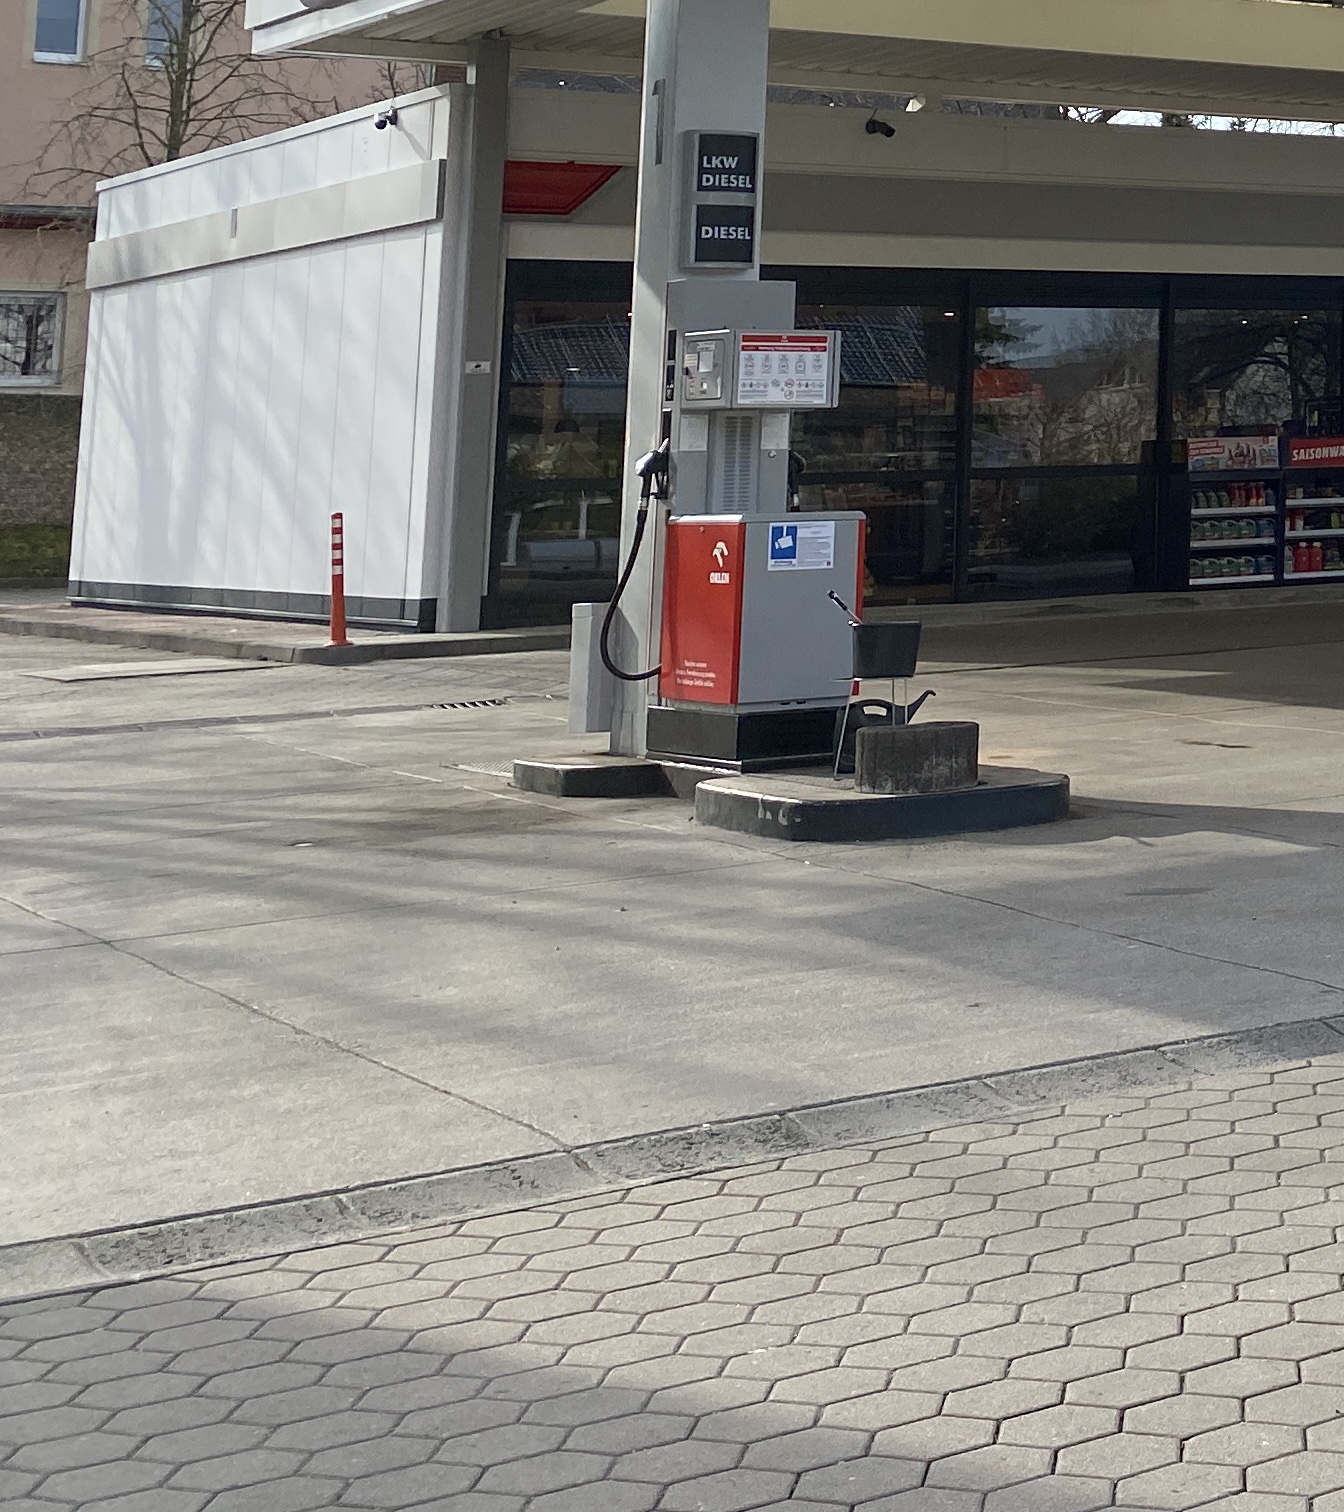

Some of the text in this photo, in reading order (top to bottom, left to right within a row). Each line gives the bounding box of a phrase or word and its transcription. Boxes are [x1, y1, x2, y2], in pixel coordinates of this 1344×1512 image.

[702, 155, 739, 170] LKW
[701, 173, 753, 188] DIESEL
[701, 226, 751, 240] DIESEL
